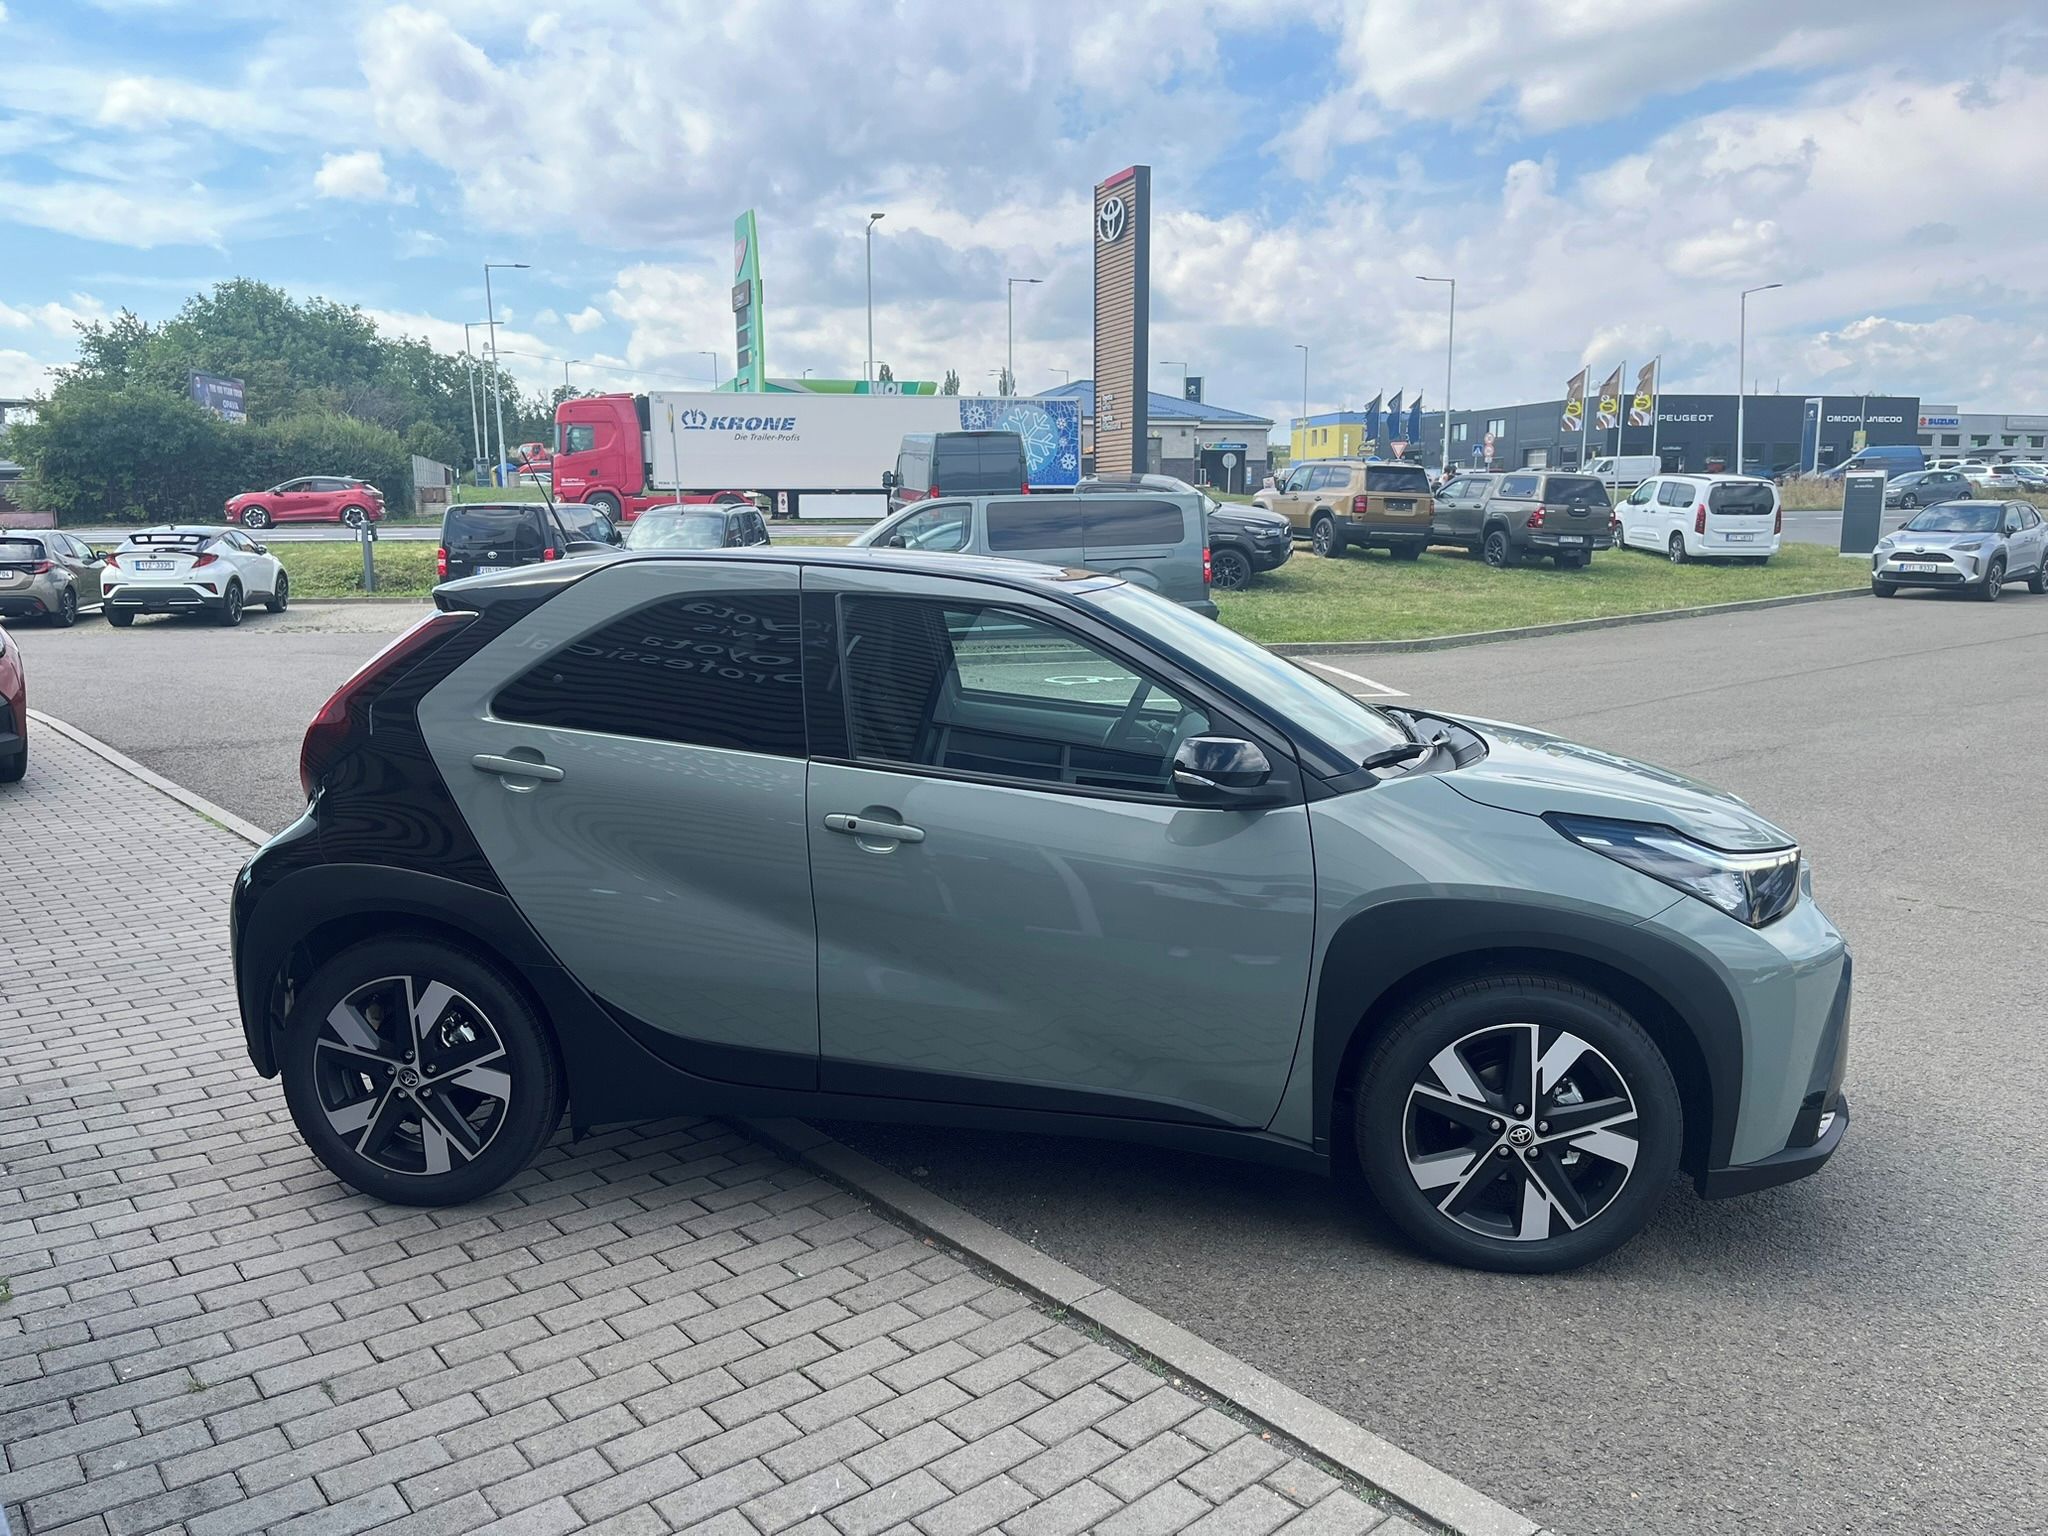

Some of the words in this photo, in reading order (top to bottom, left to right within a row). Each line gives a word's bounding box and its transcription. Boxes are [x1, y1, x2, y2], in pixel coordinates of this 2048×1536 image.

[871, 381, 904, 396] MOL
[1658, 414, 1715, 422] PEUGEOT
[1826, 415, 1862, 423] OMODA
[1866, 415, 1903, 423] JAECOO
[1927, 417, 1959, 426] SUZUKI
[708, 416, 796, 431] KRONE
[734, 433, 748, 441] Die
[750, 433, 800, 442] Trailer-Profis
